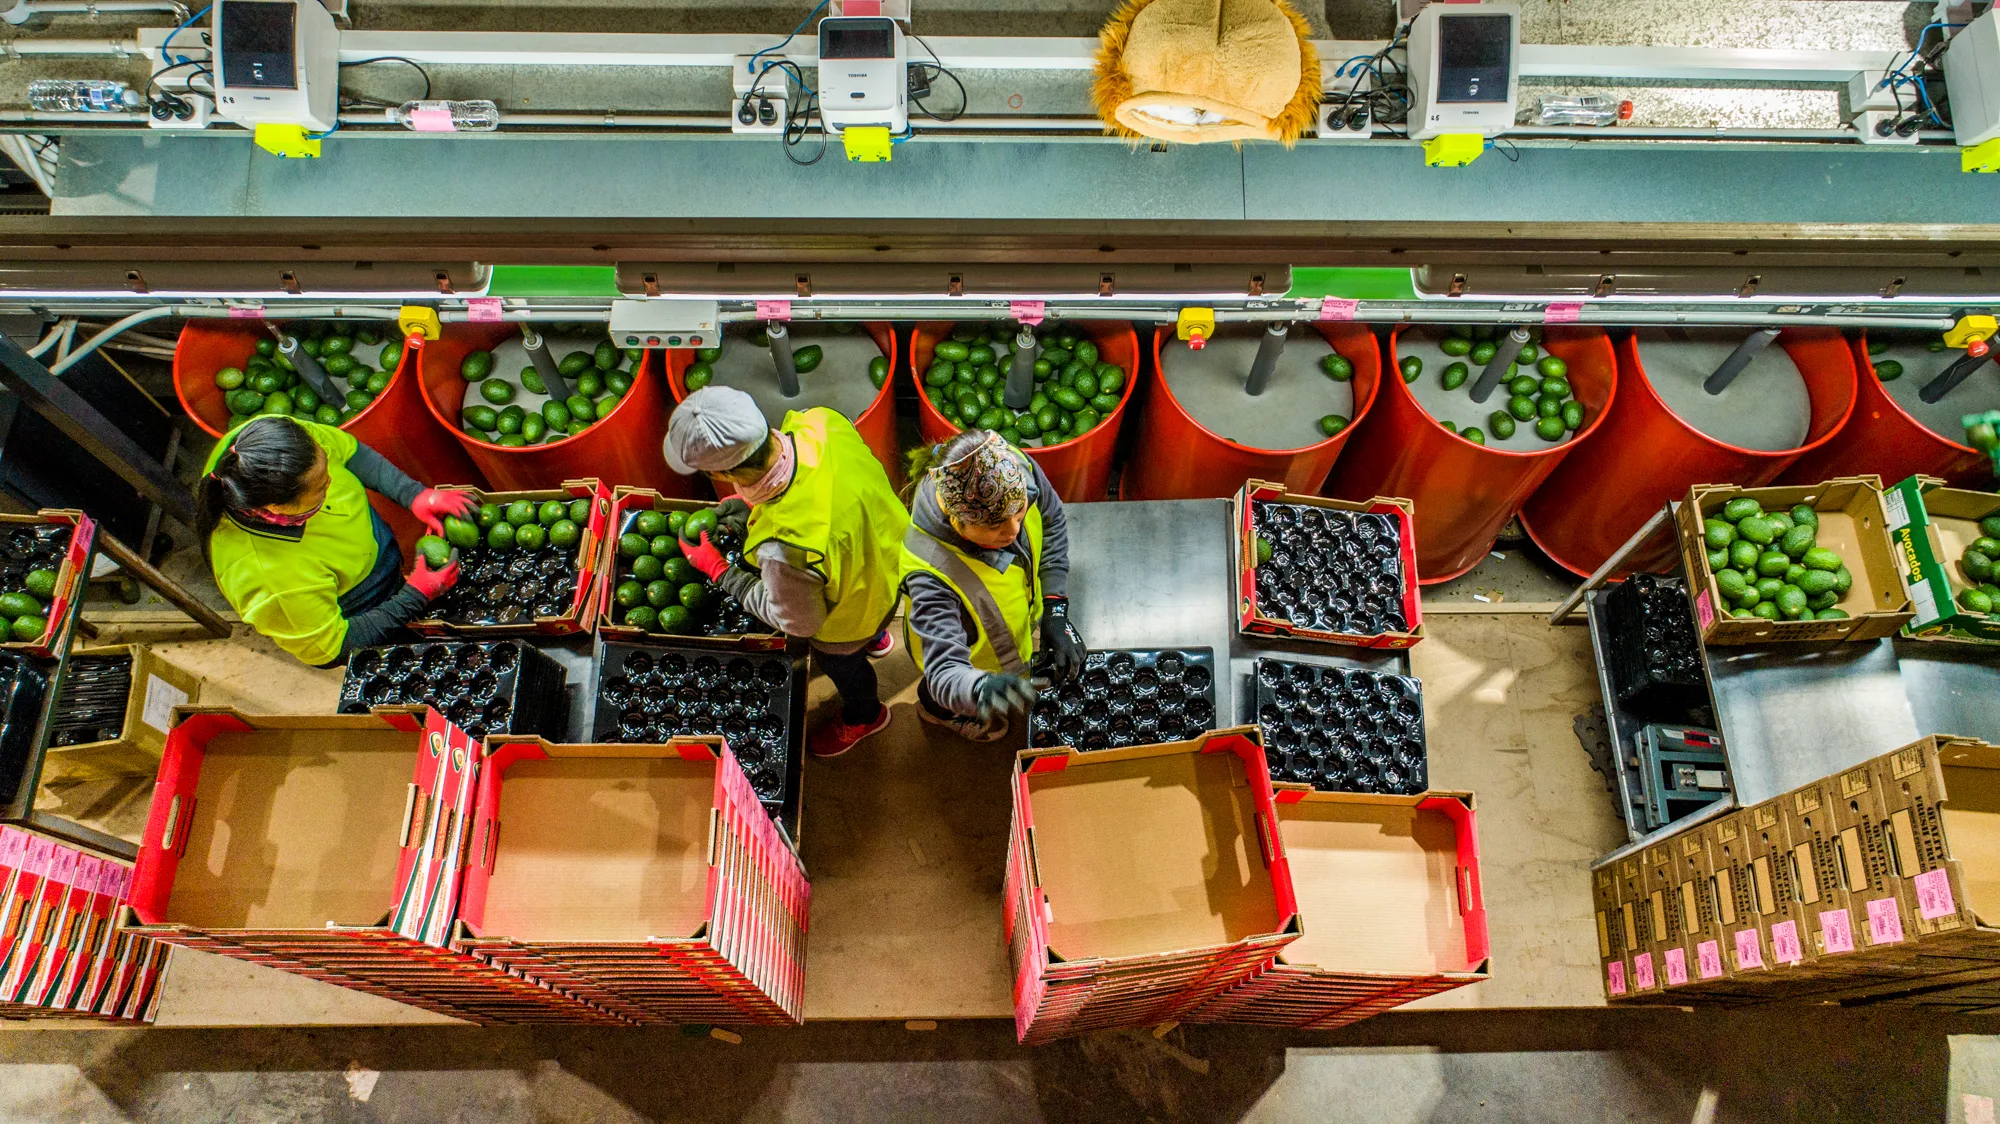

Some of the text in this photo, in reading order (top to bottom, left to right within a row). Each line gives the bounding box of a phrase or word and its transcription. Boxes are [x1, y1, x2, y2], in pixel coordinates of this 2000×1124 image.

[1900, 528, 1922, 582] Avocados
[1862, 814, 1884, 892] FRESH FRUIT
[1873, 825, 1888, 876] QUALITY
[1914, 796, 1937, 870] FRESH FRUI
[1927, 806, 1944, 860] QUALITY
[1814, 830, 1833, 904] FRESH FRUIT
[1824, 841, 1837, 889] QUALITY
